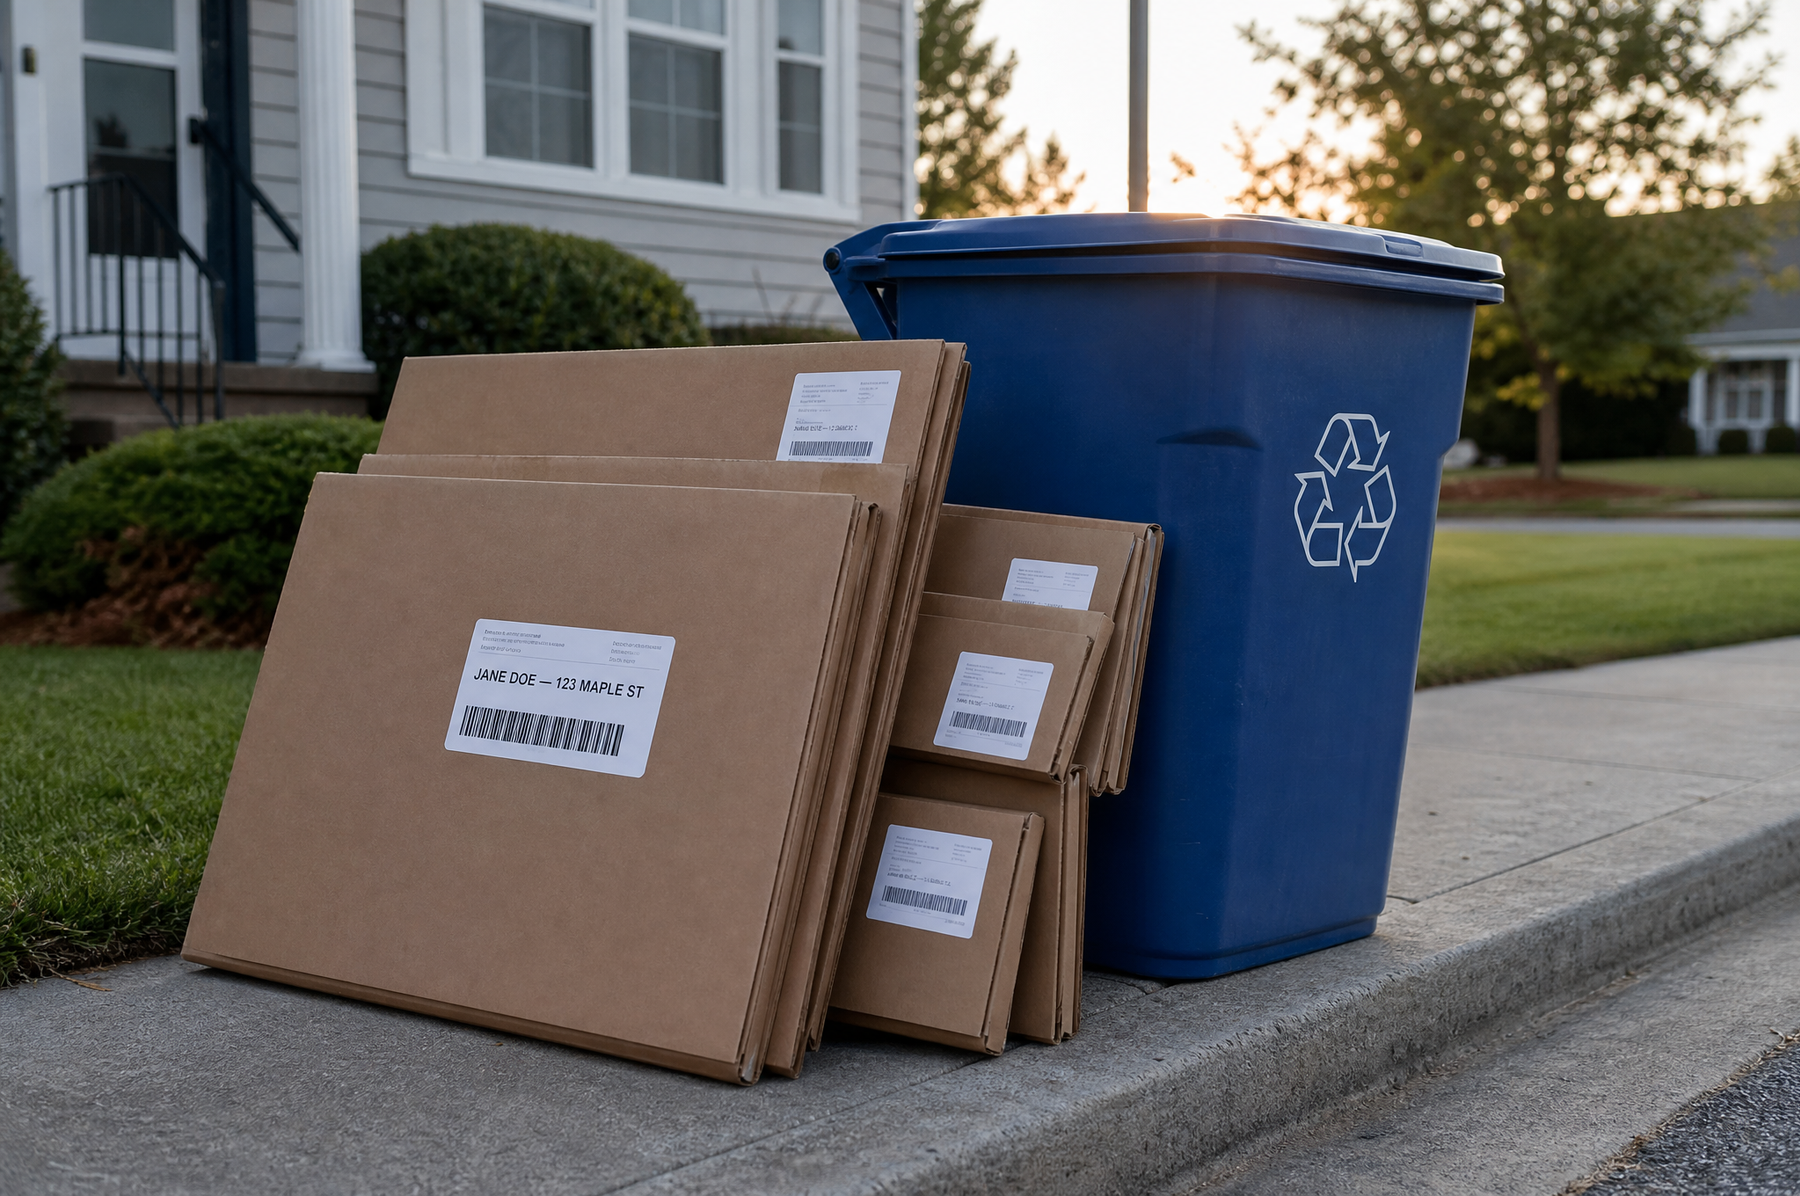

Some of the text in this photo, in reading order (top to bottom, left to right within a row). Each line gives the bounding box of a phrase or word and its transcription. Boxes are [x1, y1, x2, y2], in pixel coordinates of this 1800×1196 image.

[473, 667, 507, 683] JANE
[509, 671, 537, 687] DOE
[556, 676, 577, 691] 123
[579, 679, 625, 697] MAPLE
[626, 684, 645, 699] ST
